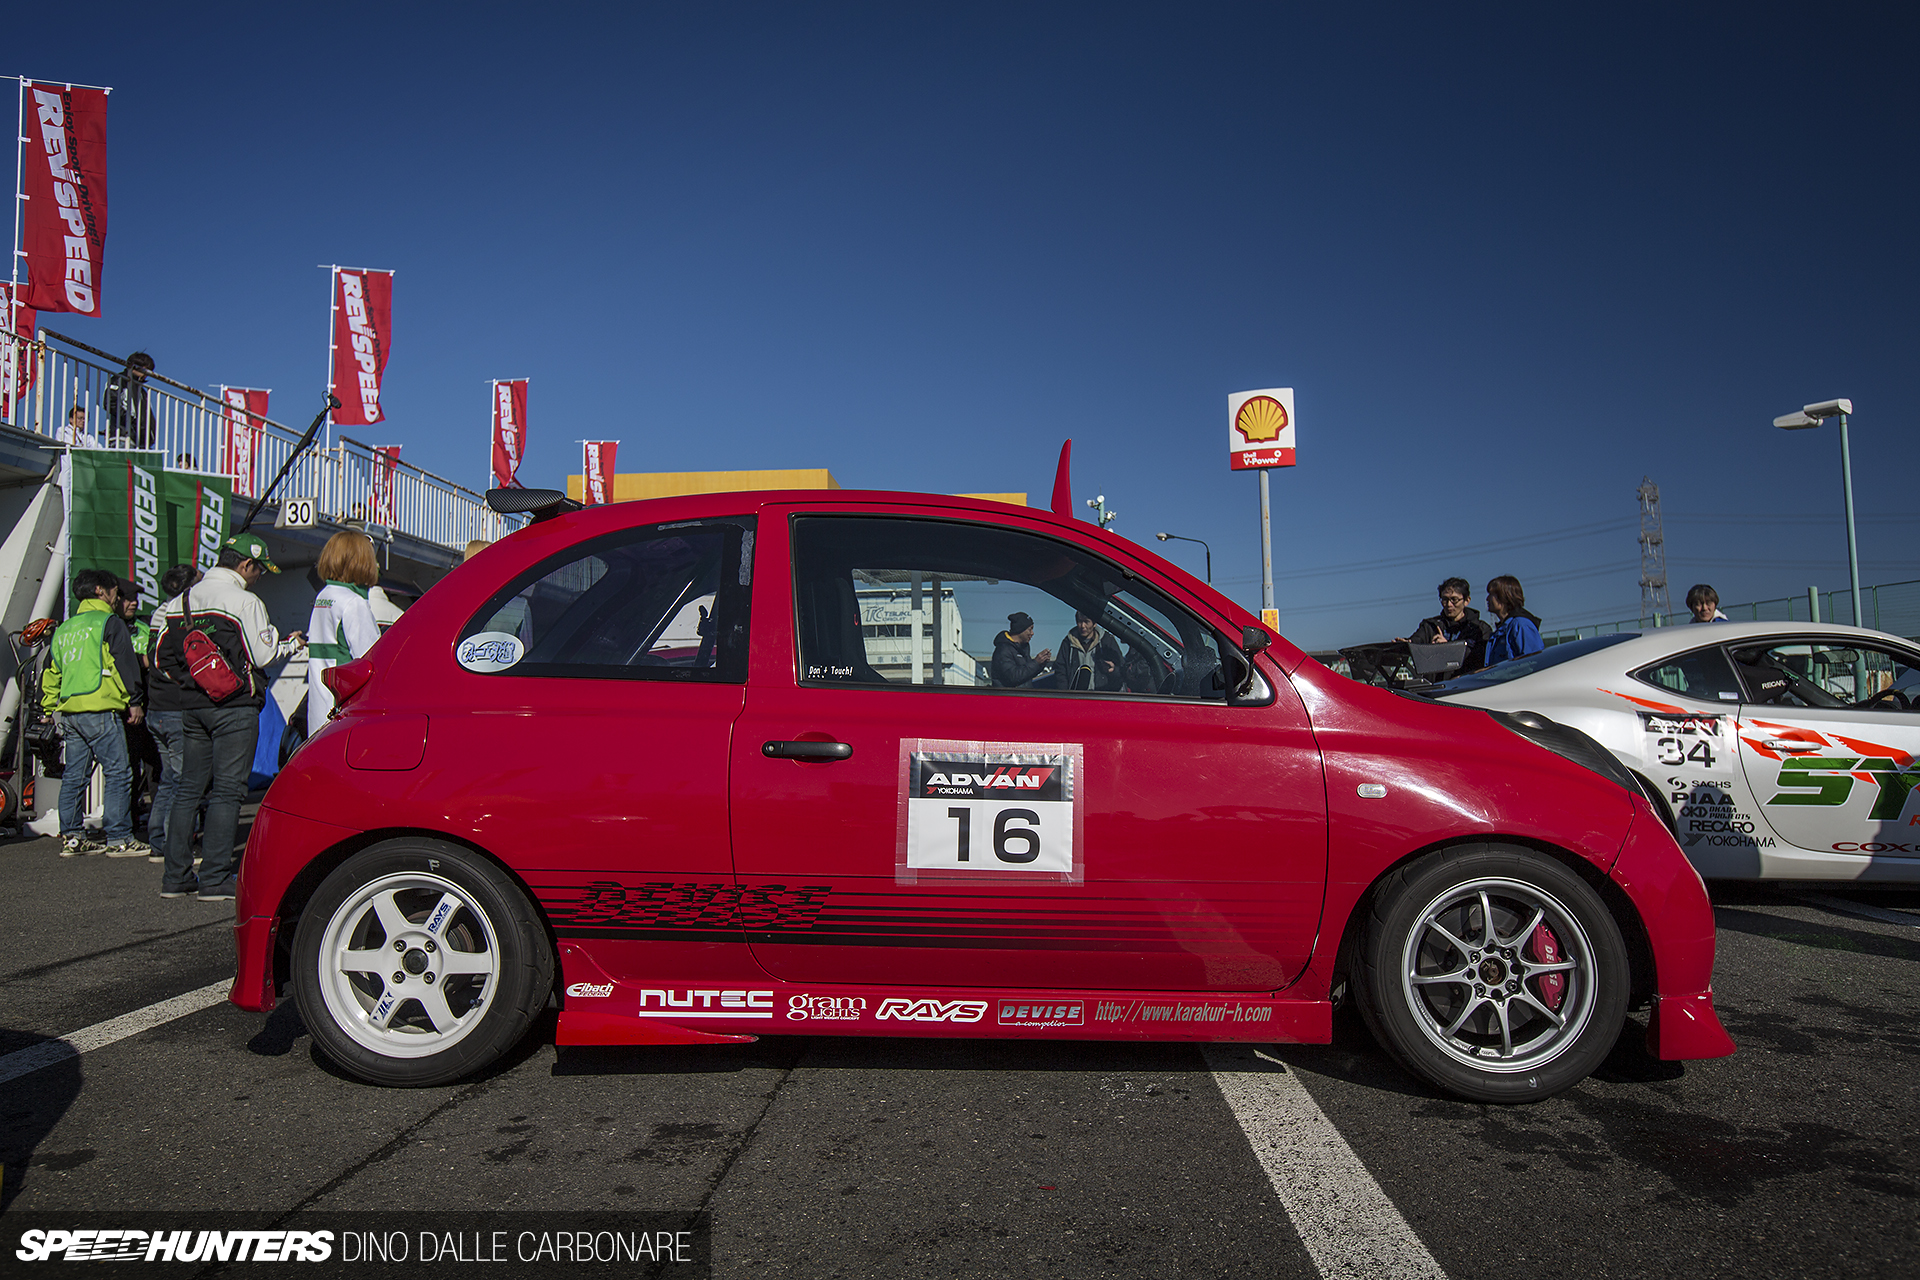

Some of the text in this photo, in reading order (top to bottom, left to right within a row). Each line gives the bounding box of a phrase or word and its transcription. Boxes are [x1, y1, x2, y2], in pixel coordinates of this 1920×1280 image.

[62, 91, 75, 136] Enjoy
[68, 136, 84, 180] Sport
[1243, 457, 1280, 466] V-Power
[288, 502, 310, 524] 30
[133, 465, 159, 611] FEDERAL
[1658, 738, 1716, 768] 34
[926, 772, 1040, 788] ADVAN
[1691, 780, 1731, 789] SACHS
[937, 787, 974, 795] YOKOHAMA
[1671, 792, 1735, 805] PIAA
[947, 807, 1041, 864] 16
[1689, 820, 1755, 833] RECARO
[1706, 835, 1776, 848] YOKOHAMA
[1831, 842, 1911, 852] COX
[427, 902, 449, 932] RAYS
[640, 989, 774, 1008] NUTEC
[786, 993, 867, 1020] gram
[811, 1008, 860, 1017] LIGHTS
[876, 998, 988, 1022] RAYS
[1000, 1005, 1081, 1018] DEVISE
[1095, 1000, 1272, 1023] http://www.karakuri-h.com
